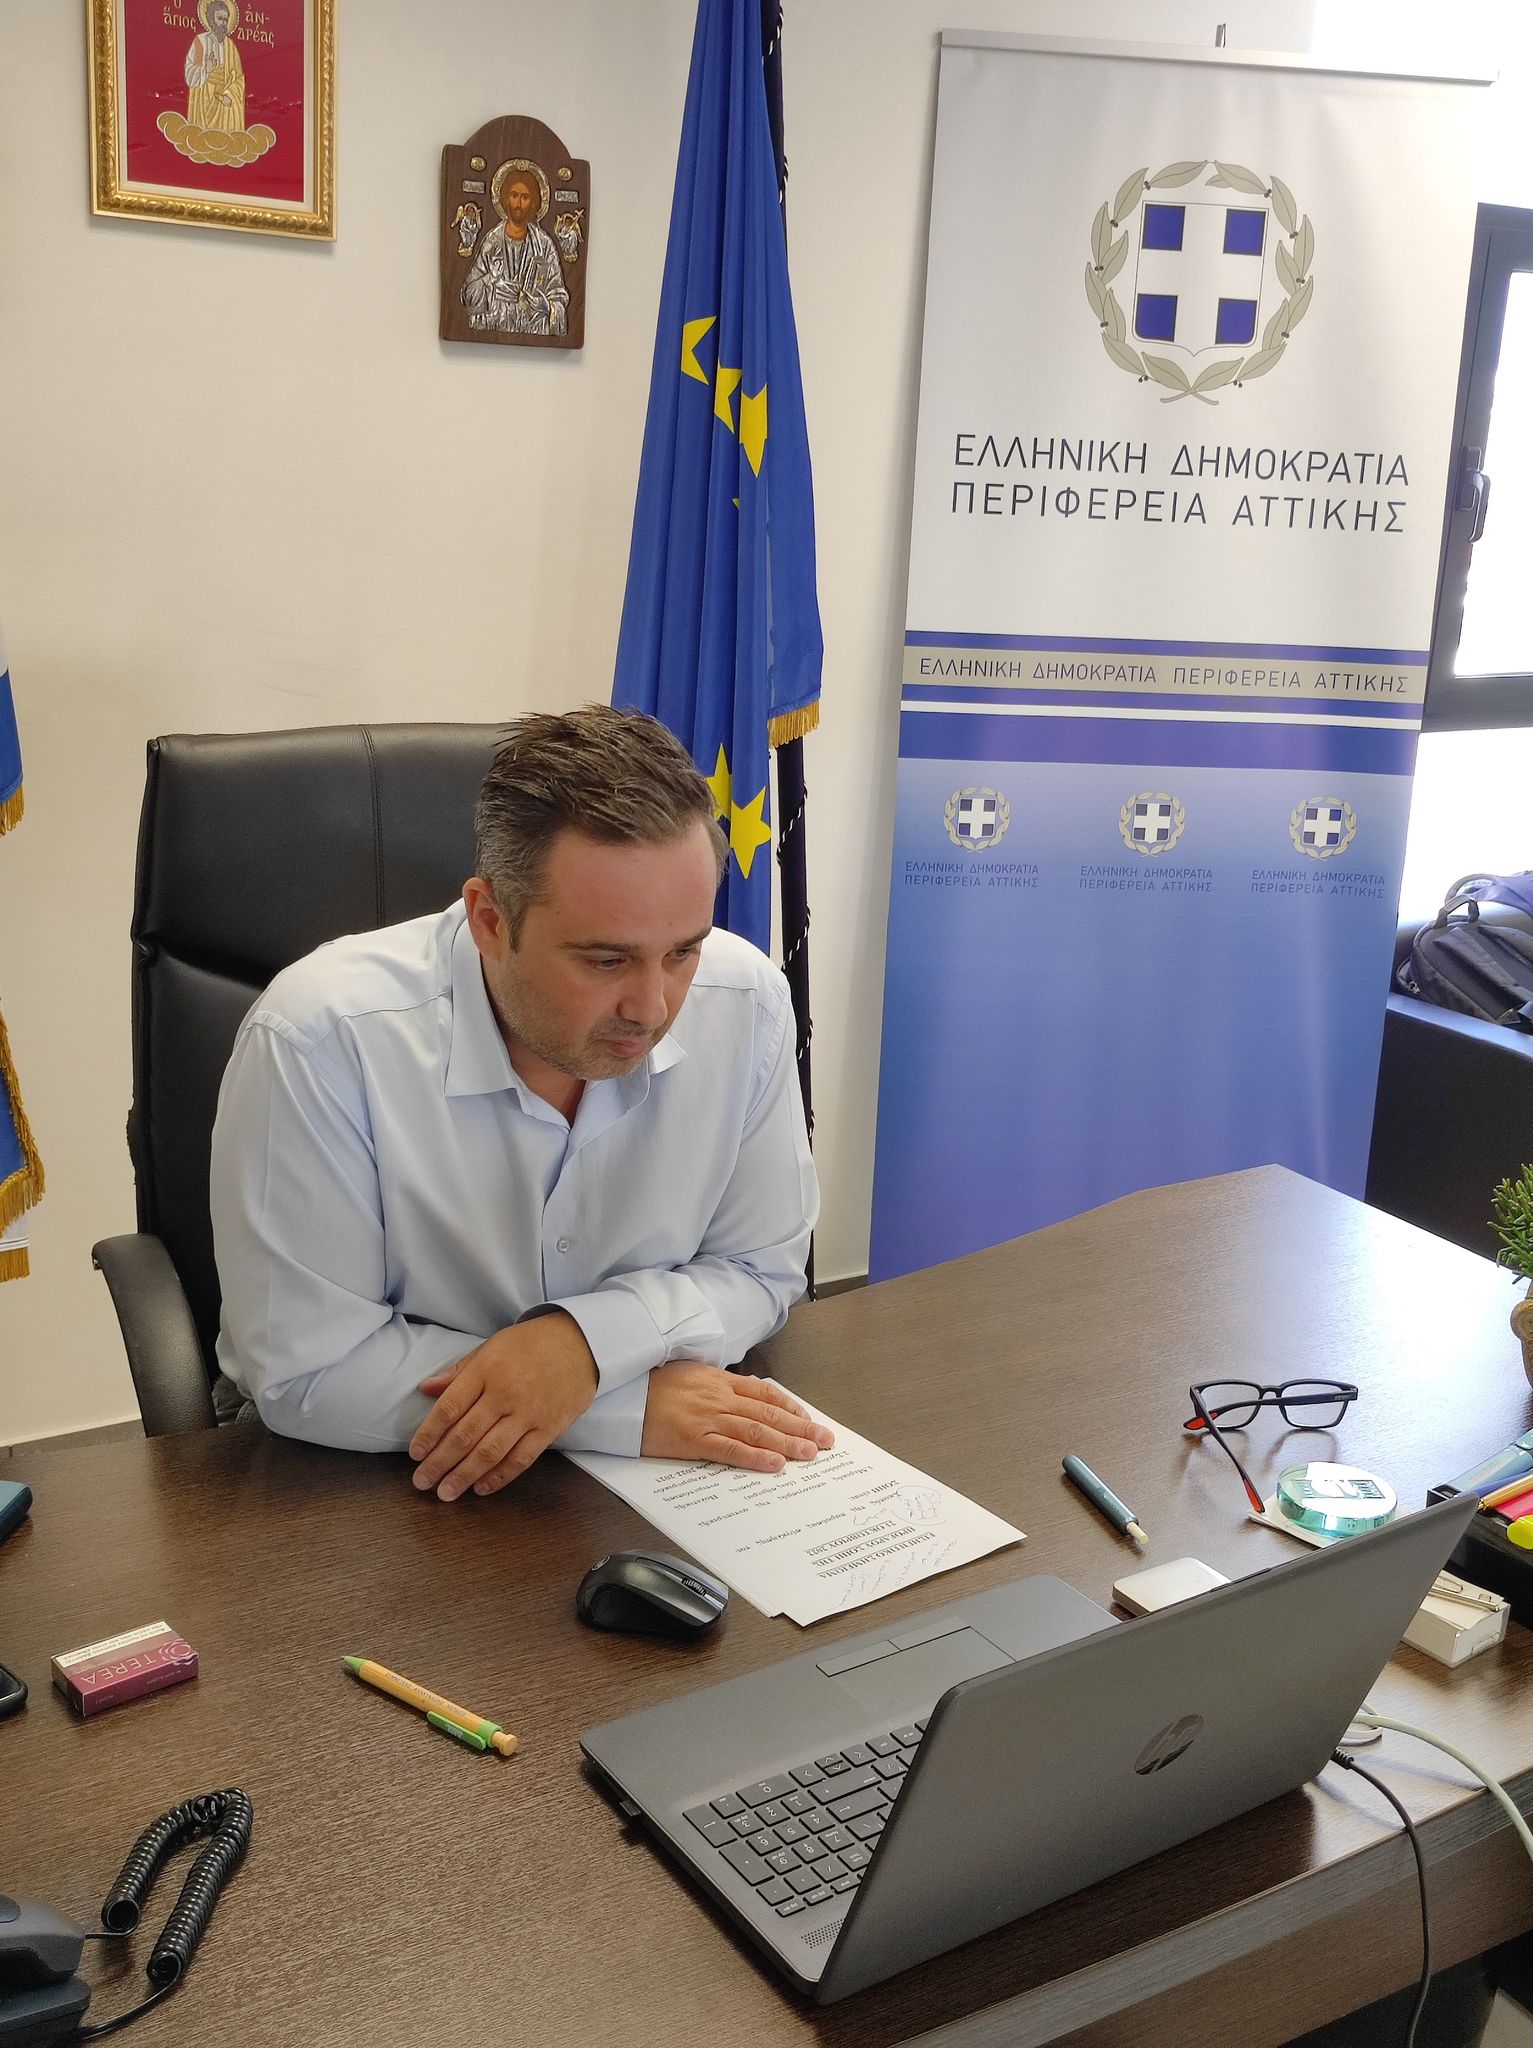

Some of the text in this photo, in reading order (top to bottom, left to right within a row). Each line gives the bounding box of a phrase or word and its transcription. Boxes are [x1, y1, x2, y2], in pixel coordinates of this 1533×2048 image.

[955, 434, 1409, 486] ΕΛΛΗΝΙΚΗ ΔΗΜΟΚΡΑΤΙΑ
[952, 482, 1406, 532] ΠΕΡΙΦΕΡΕΙΑ ΑΤΤΙΚΗΣ
[920, 658, 1408, 693] ΕΛΛΗΝΙΚΗ ΔΗΜΟΚΡΑΤΙΑ ΠΕΡΙΦΕΡΕΙΑ ΑΤΤΙΚΗΣ
[905, 861, 1039, 874] ΕΛΛΗΝΙΚΗ ΔΗΜΟΚΡΑΤΙΑ
[1080, 866, 1213, 879] ΕΛΛΗΝΙΚΗ ΔΗΜΟΚΡΑΤΙΑ
[905, 874, 1038, 888] ΠΕΡΙΦΕΡΕΙΑ ΑΤΤΙΚΗΣ
[1252, 869, 1385, 885] ΕΛΛΗΝΙΚΗ ΔΗΜΟΚΡΑΤΙΑ
[1080, 879, 1212, 892] ΠΕΡΙΦΕΡΕΙΑ ΑΤΤΙΚΗΣ
[1251, 882, 1385, 898] ΠΕΡΙΦΕΡΕΙΑ ΑΤΤΙΚΗΣ
[81, 1654, 156, 1684] TEREA
